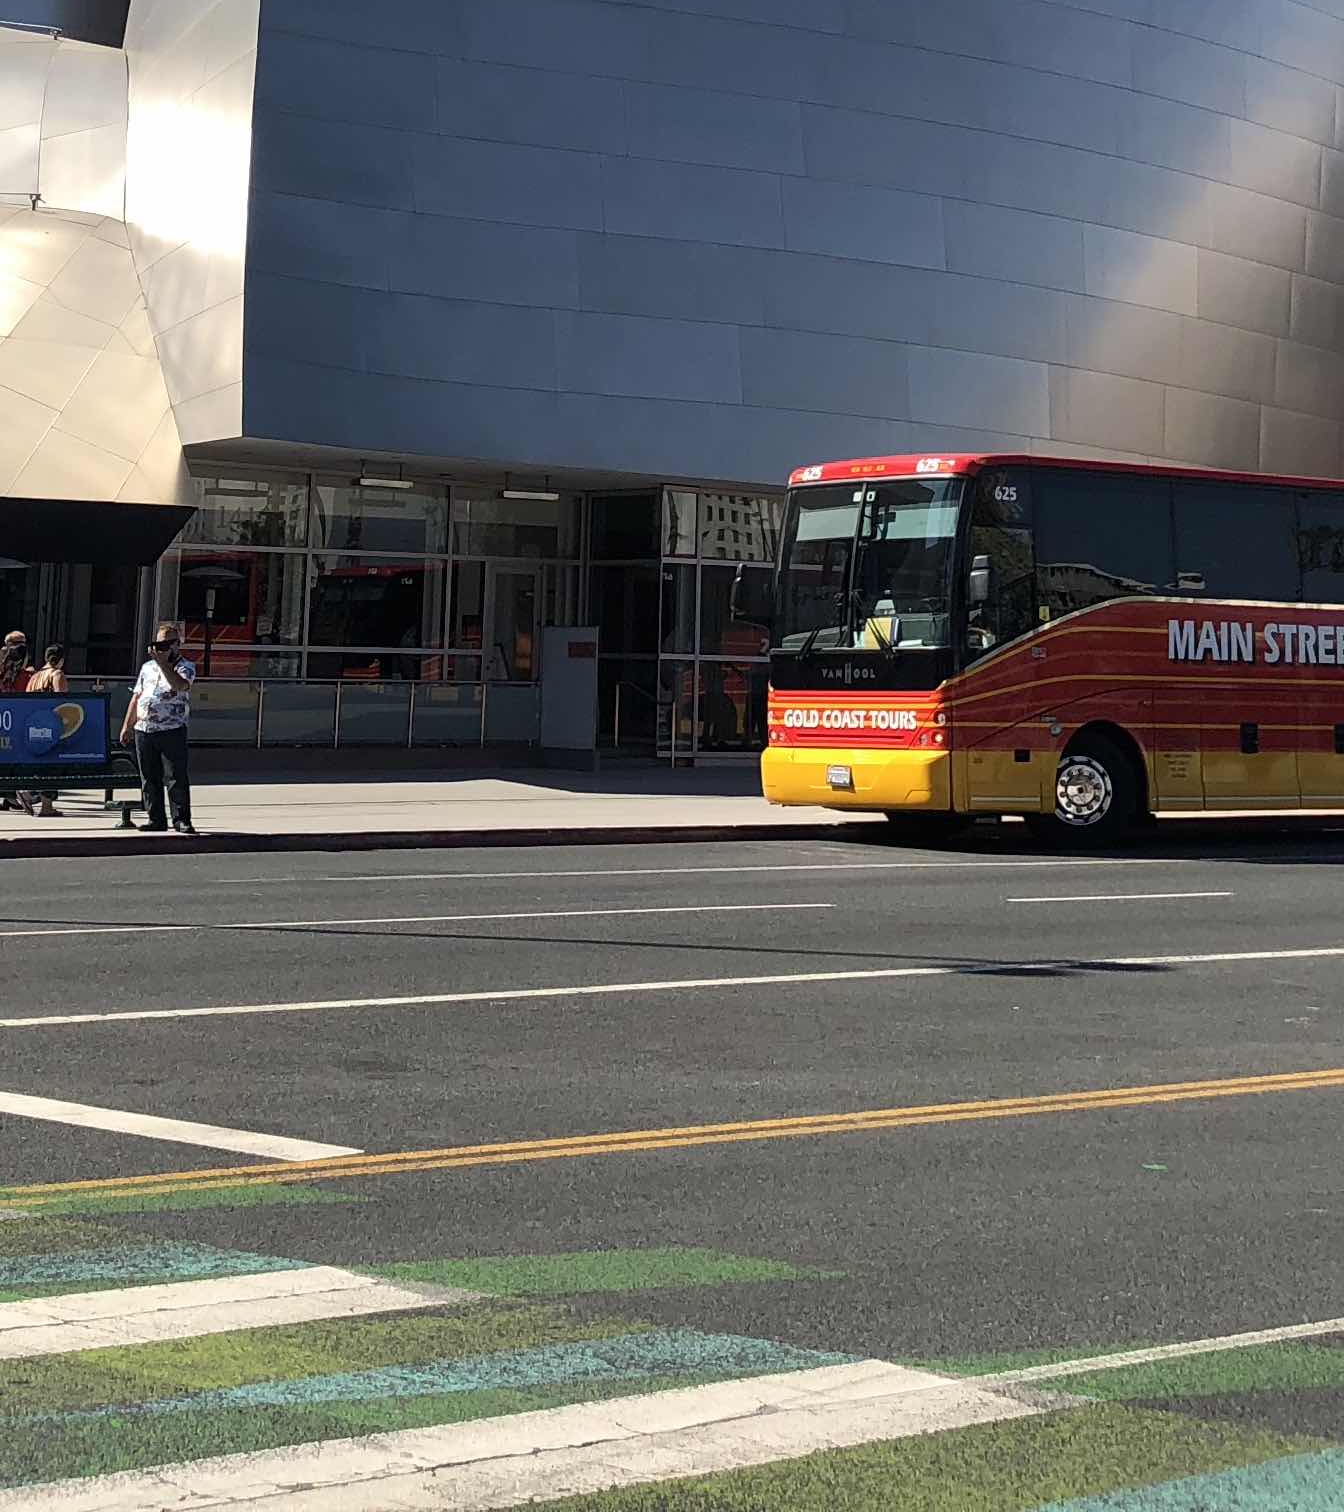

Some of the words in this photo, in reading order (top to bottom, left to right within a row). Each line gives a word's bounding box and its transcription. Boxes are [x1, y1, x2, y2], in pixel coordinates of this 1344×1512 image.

[994, 485, 1017, 501] 625
[1168, 619, 1253, 662] MAIN
[784, 709, 819, 728] GOLD
[822, 709, 866, 729] COAST
[869, 710, 917, 730] TOURS
